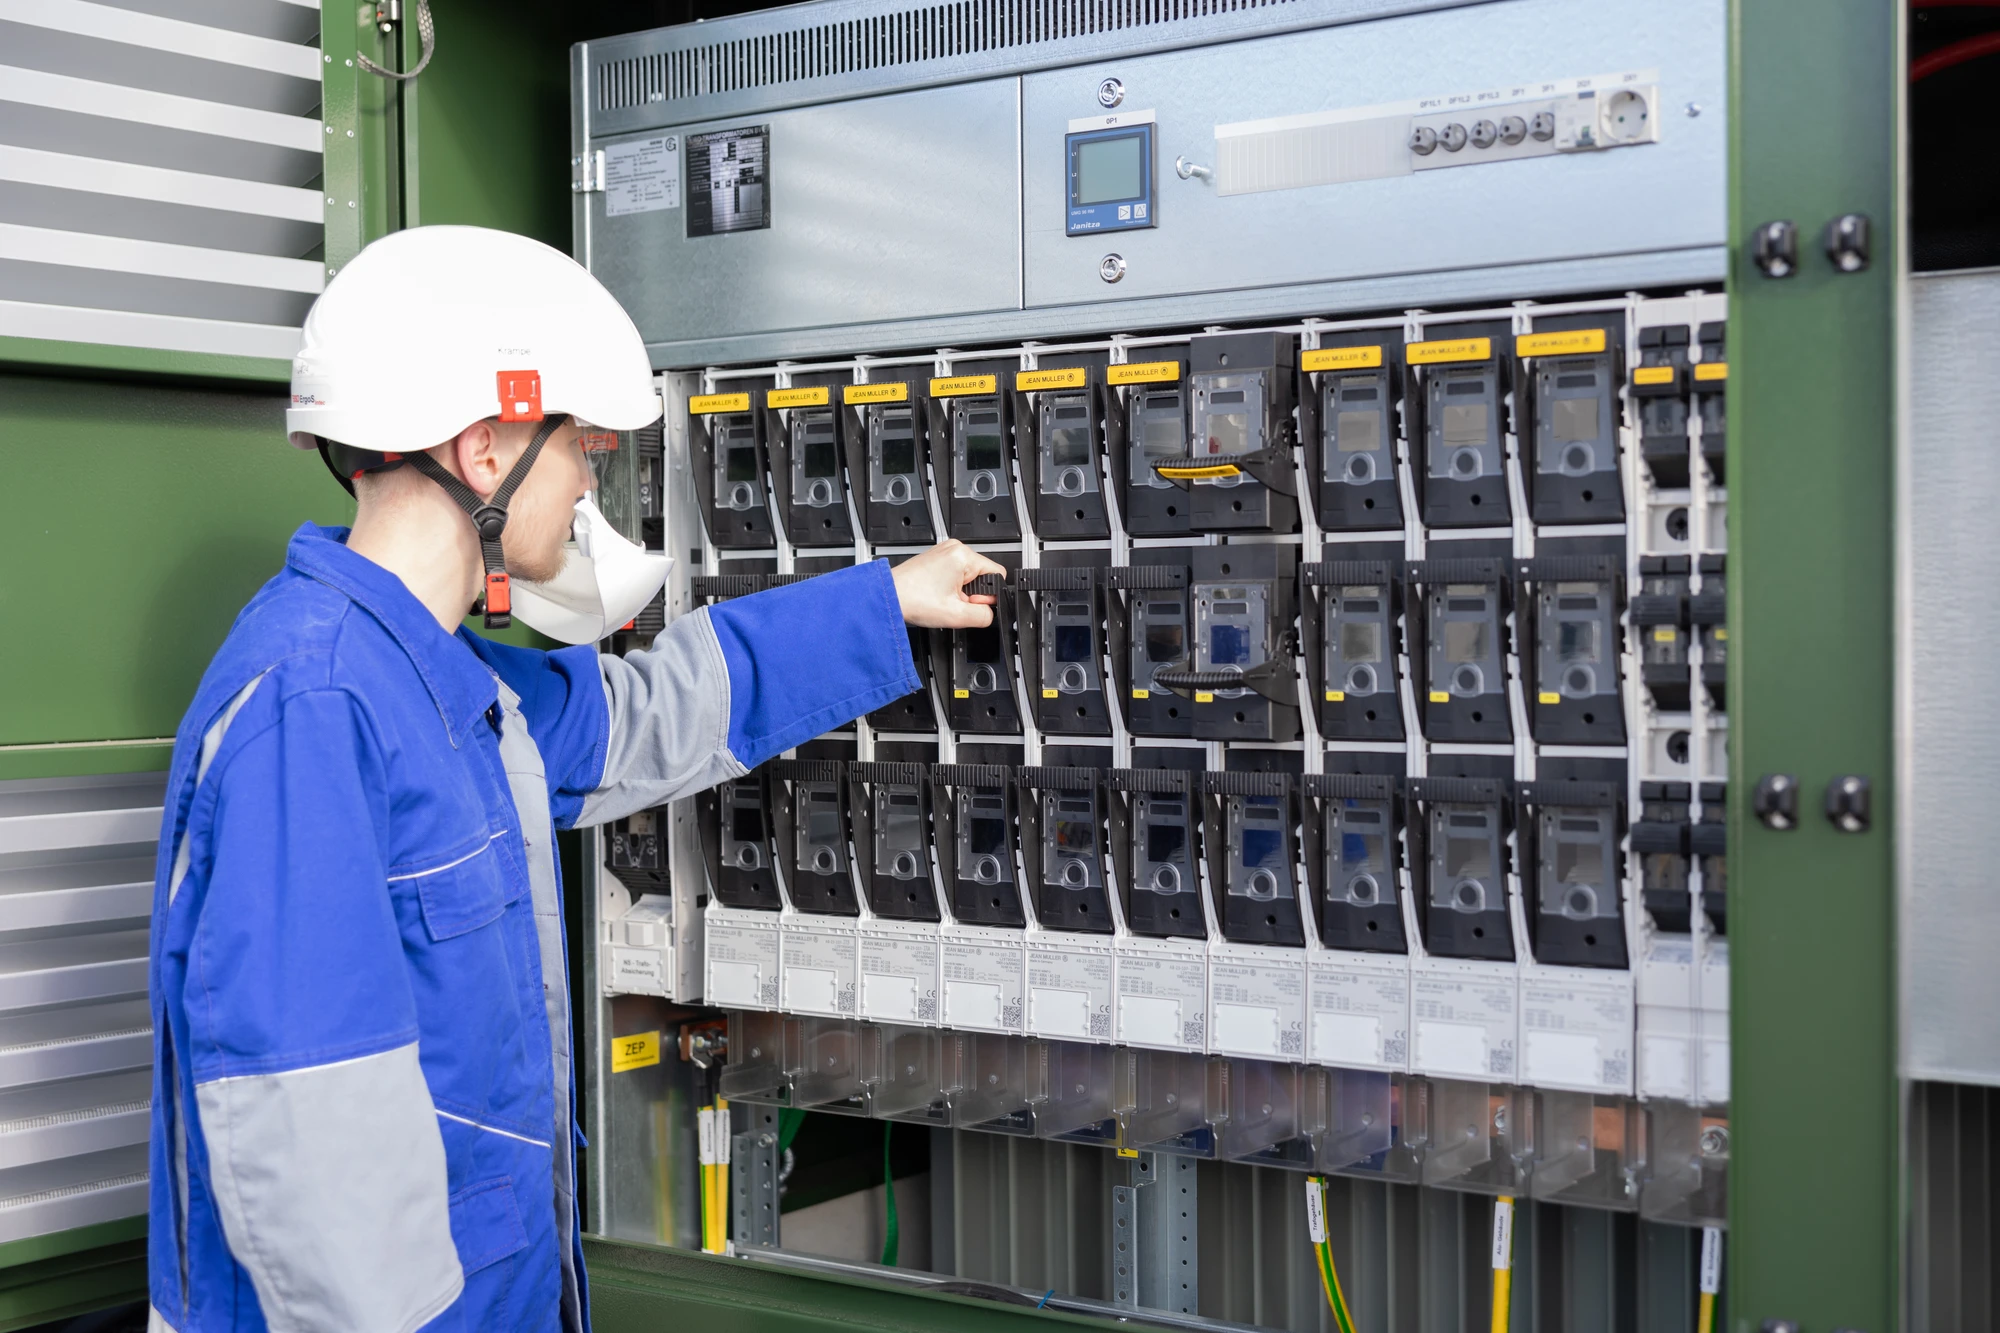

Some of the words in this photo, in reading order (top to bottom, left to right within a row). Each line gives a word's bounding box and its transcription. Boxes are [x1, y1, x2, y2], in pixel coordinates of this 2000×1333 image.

[1071, 221, 1100, 230] Janitza
[300, 395, 314, 405] ErgoS
[621, 968, 654, 977] Absicherung
[625, 1041, 645, 1056] ZEP
